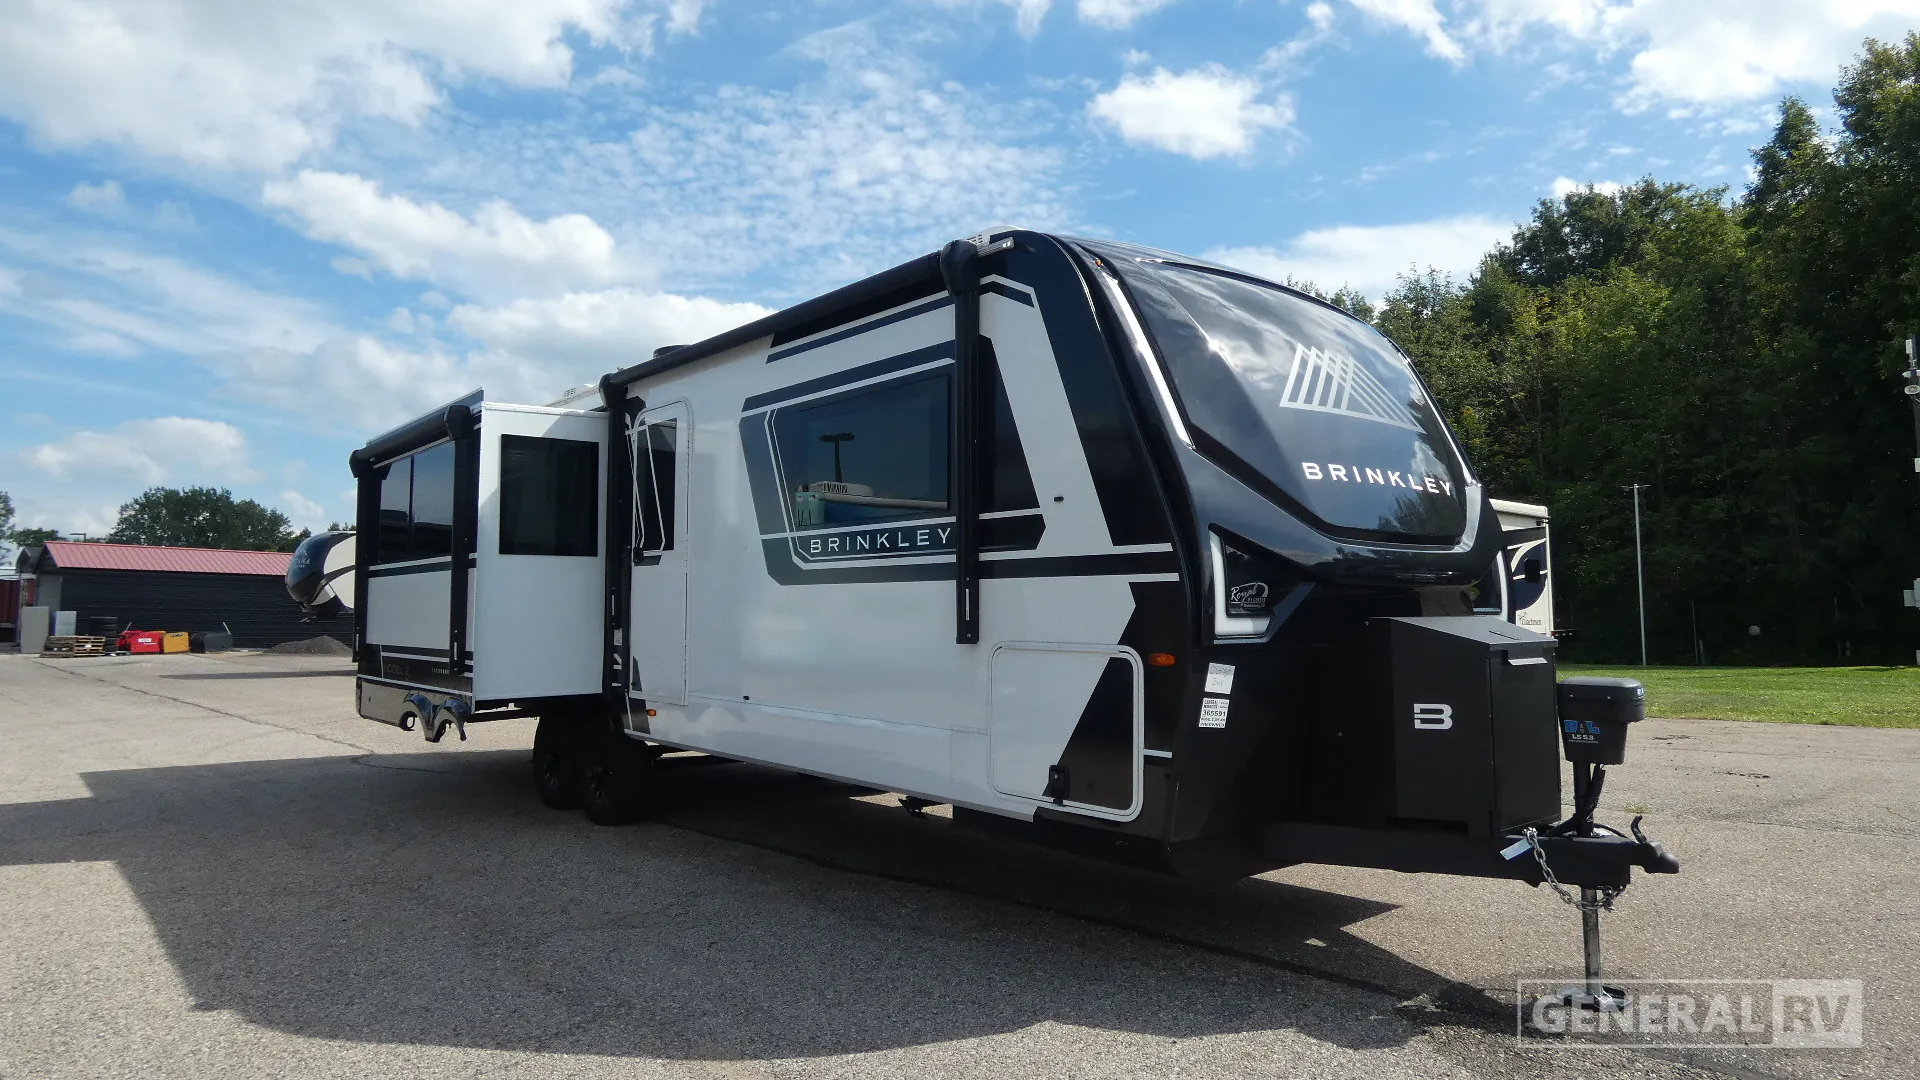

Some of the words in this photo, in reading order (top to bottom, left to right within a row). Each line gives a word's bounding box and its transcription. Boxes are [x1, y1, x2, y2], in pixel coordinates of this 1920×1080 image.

[1301, 462, 1451, 496] BRINKLEY
[810, 527, 951, 553] BRINKLEY
[1230, 582, 1257, 602] Royal
[1202, 709, 1226, 717] 365591
[1413, 703, 1453, 729] B
